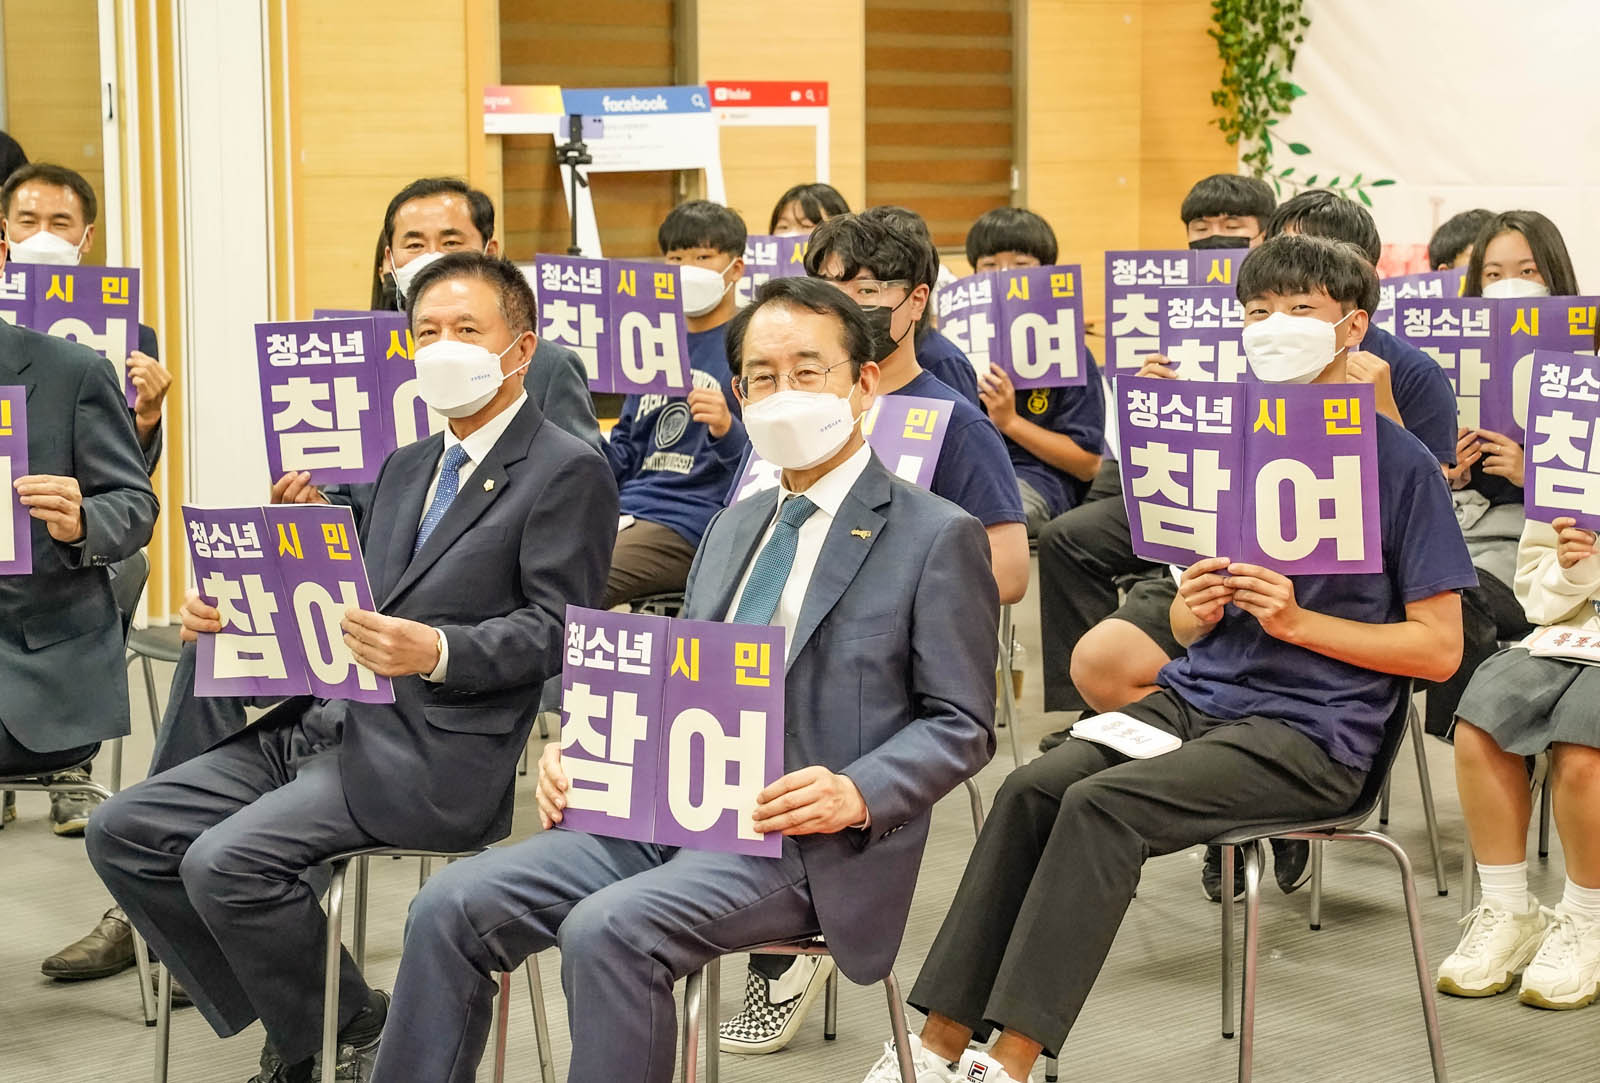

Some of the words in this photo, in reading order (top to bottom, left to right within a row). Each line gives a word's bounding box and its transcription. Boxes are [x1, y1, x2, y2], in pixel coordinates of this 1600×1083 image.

[602, 94, 668, 112] facebook
[541, 263, 602, 295] 청소년
[1112, 258, 1189, 286] 청소년
[1167, 297, 1246, 329] 청소년
[1403, 306, 1491, 338] 청소년
[266, 330, 366, 367] 청소년
[1127, 389, 1233, 434] 청소년
[190, 519, 264, 561] 청소년
[567, 621, 653, 676] 청소년
